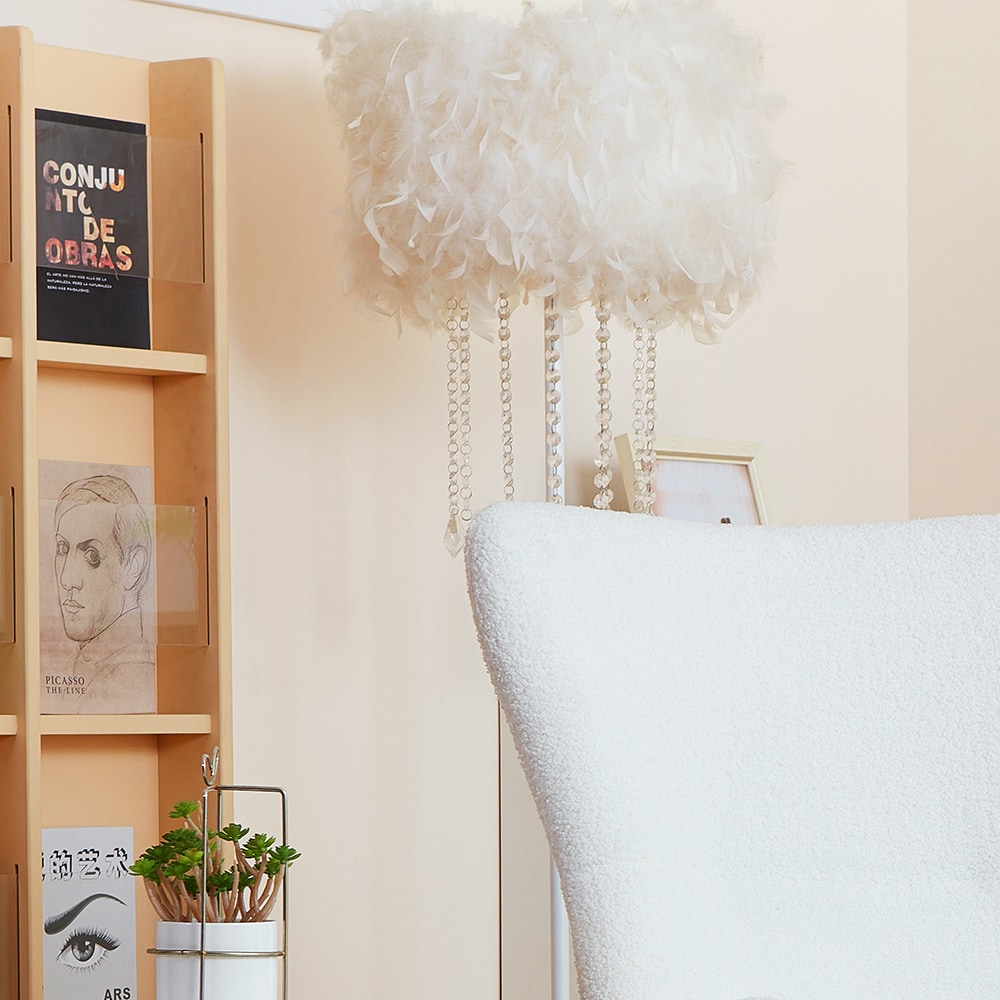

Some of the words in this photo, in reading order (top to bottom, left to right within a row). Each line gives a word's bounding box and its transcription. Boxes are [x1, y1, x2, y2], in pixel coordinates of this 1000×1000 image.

[43, 160, 125, 192] CONJU
[83, 216, 115, 243] DE
[45, 238, 133, 271] OBRAS
[45, 675, 85, 686] PICASSO
[46, 686, 62, 694] THE
[66, 687, 87, 695] LINE
[42, 847, 128, 882] 的艺术
